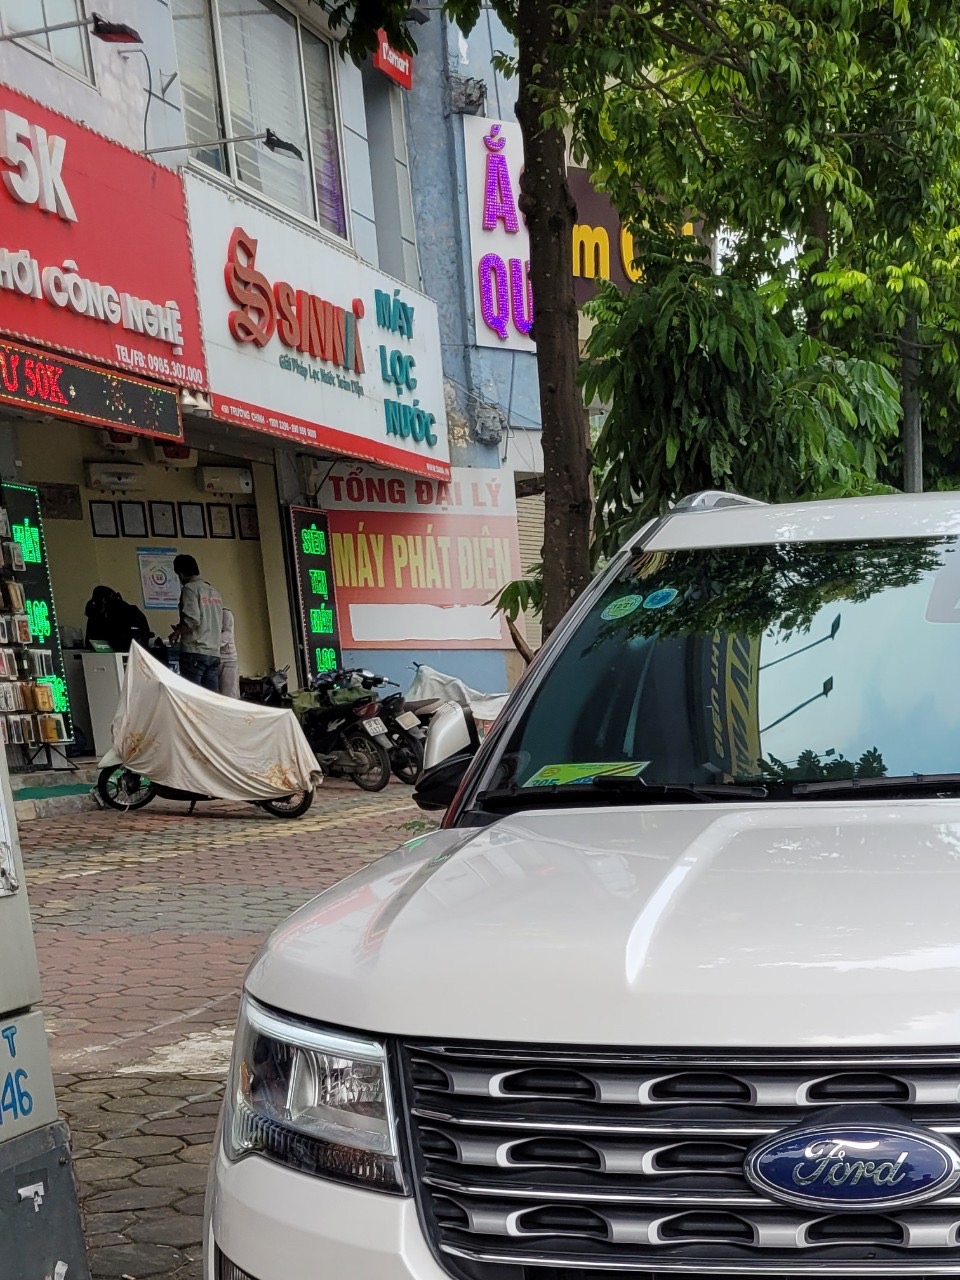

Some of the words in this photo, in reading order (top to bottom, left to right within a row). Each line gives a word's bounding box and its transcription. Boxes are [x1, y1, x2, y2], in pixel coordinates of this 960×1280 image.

[0, 109, 78, 222] 5K
[482, 123, 522, 233] Ắ
[42, 260, 121, 324] CÔNG
[120, 300, 184, 355] NGHỆ
[375, 289, 415, 340] MÁY
[24, 358, 69, 405] 50K
[379, 344, 417, 396] LỌC
[383, 398, 438, 447] NƯỚC
[328, 467, 406, 503] TỔNG
[471, 474, 502, 508] LÝ
[331, 521, 386, 588] MÁY
[391, 523, 453, 590] PHÁT
[457, 524, 514, 597] ĐIỆN
[0, 1068, 33, 1125] 46
[792, 1139, 909, 1187] Ford
